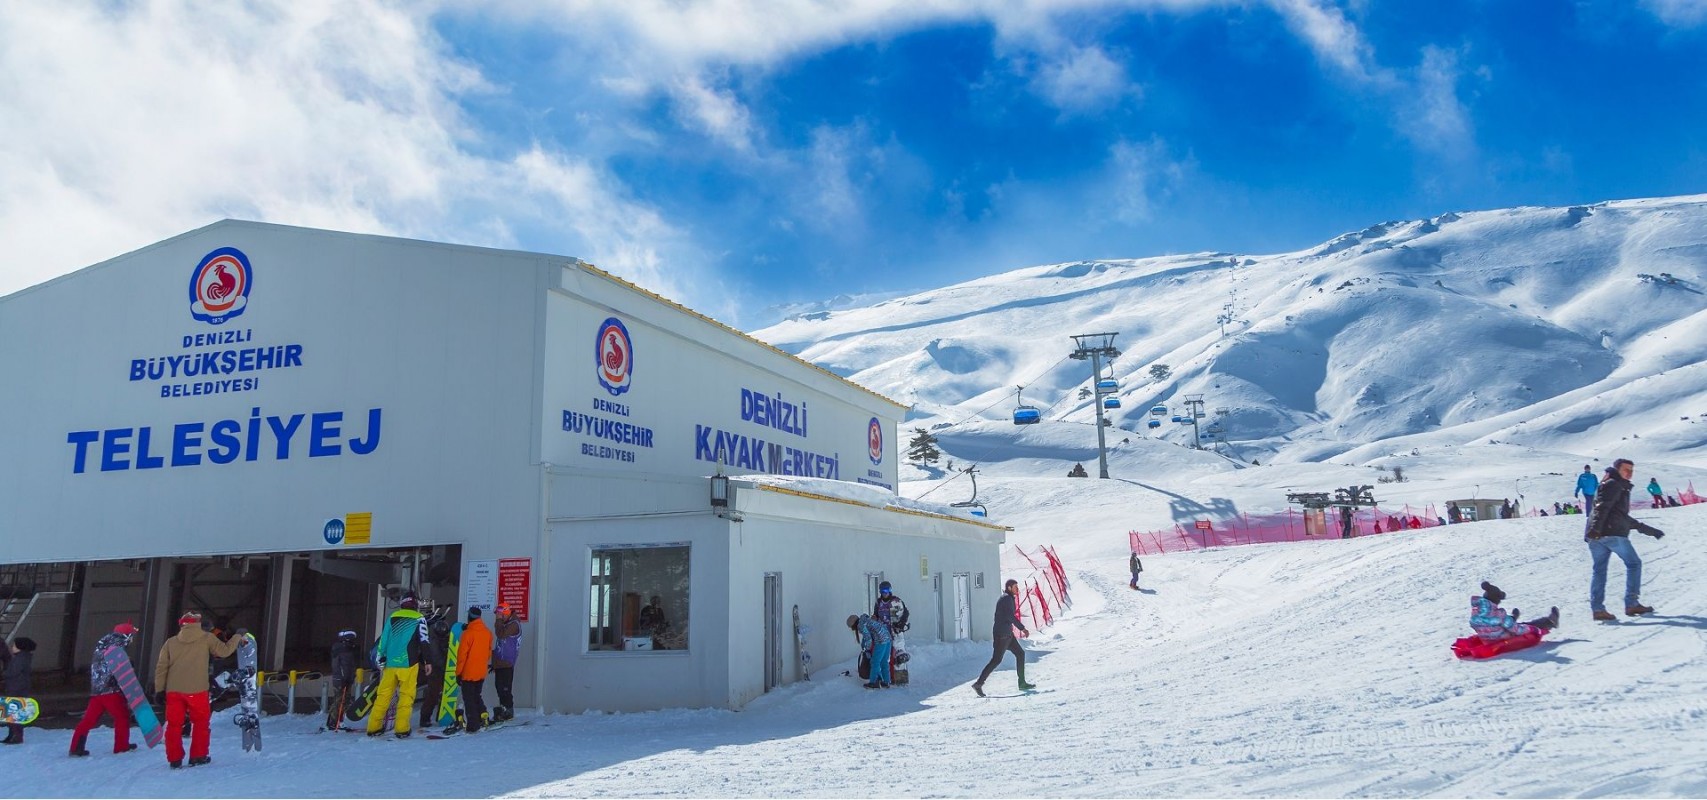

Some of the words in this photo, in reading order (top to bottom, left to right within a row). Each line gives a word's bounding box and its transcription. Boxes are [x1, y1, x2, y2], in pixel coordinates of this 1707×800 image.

[183, 329, 252, 348] DENİZLİ
[129, 344, 303, 381] BÜYÜKŞEHİR
[161, 378, 259, 398] BELEDİYESİ
[562, 409, 654, 448] BÜYÜKŞEHİR
[741, 388, 807, 438] DENİZLİ
[67, 407, 382, 474] TELESİYEJ
[695, 424, 766, 473] KAYAK
